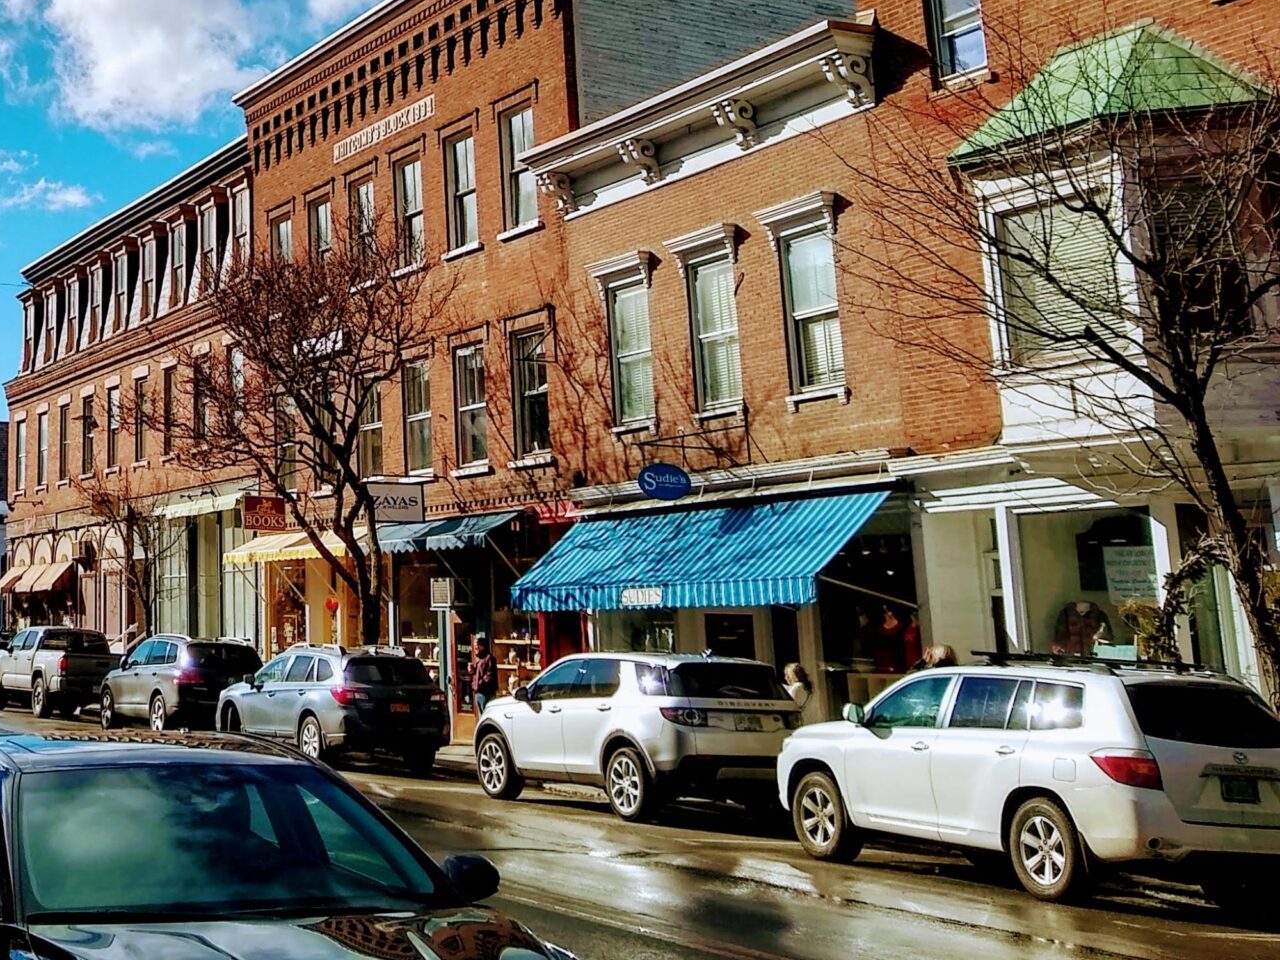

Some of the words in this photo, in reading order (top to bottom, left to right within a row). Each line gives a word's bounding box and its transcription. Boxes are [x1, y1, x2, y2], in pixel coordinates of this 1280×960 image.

[382, 108, 410, 138] BLOCK
[644, 472, 687, 490] Sudie's
[246, 515, 286, 528] BOOKS
